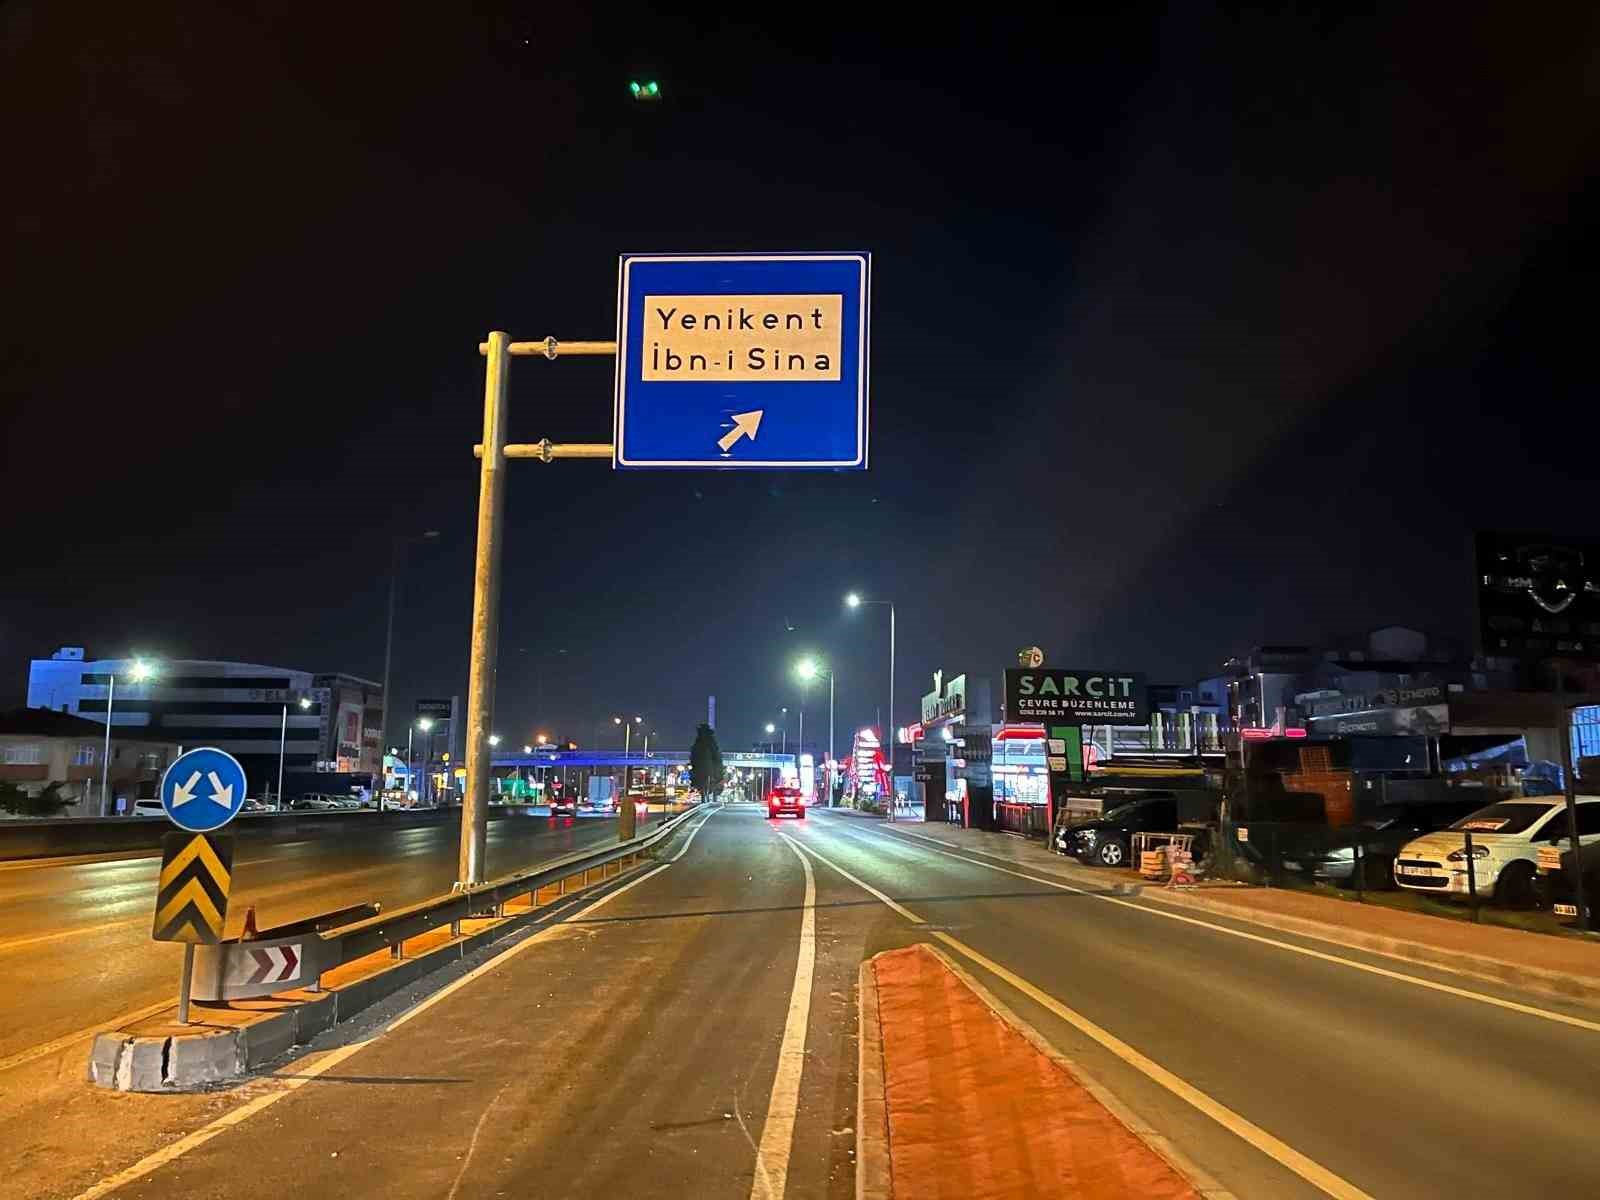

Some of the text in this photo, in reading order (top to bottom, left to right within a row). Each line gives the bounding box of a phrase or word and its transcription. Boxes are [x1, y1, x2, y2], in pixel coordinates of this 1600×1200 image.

[656, 307, 823, 330] Yenikent
[652, 342, 831, 371] İbn-i Sina
[1018, 698, 1135, 710] ÇEVRE DÜZENLEME
